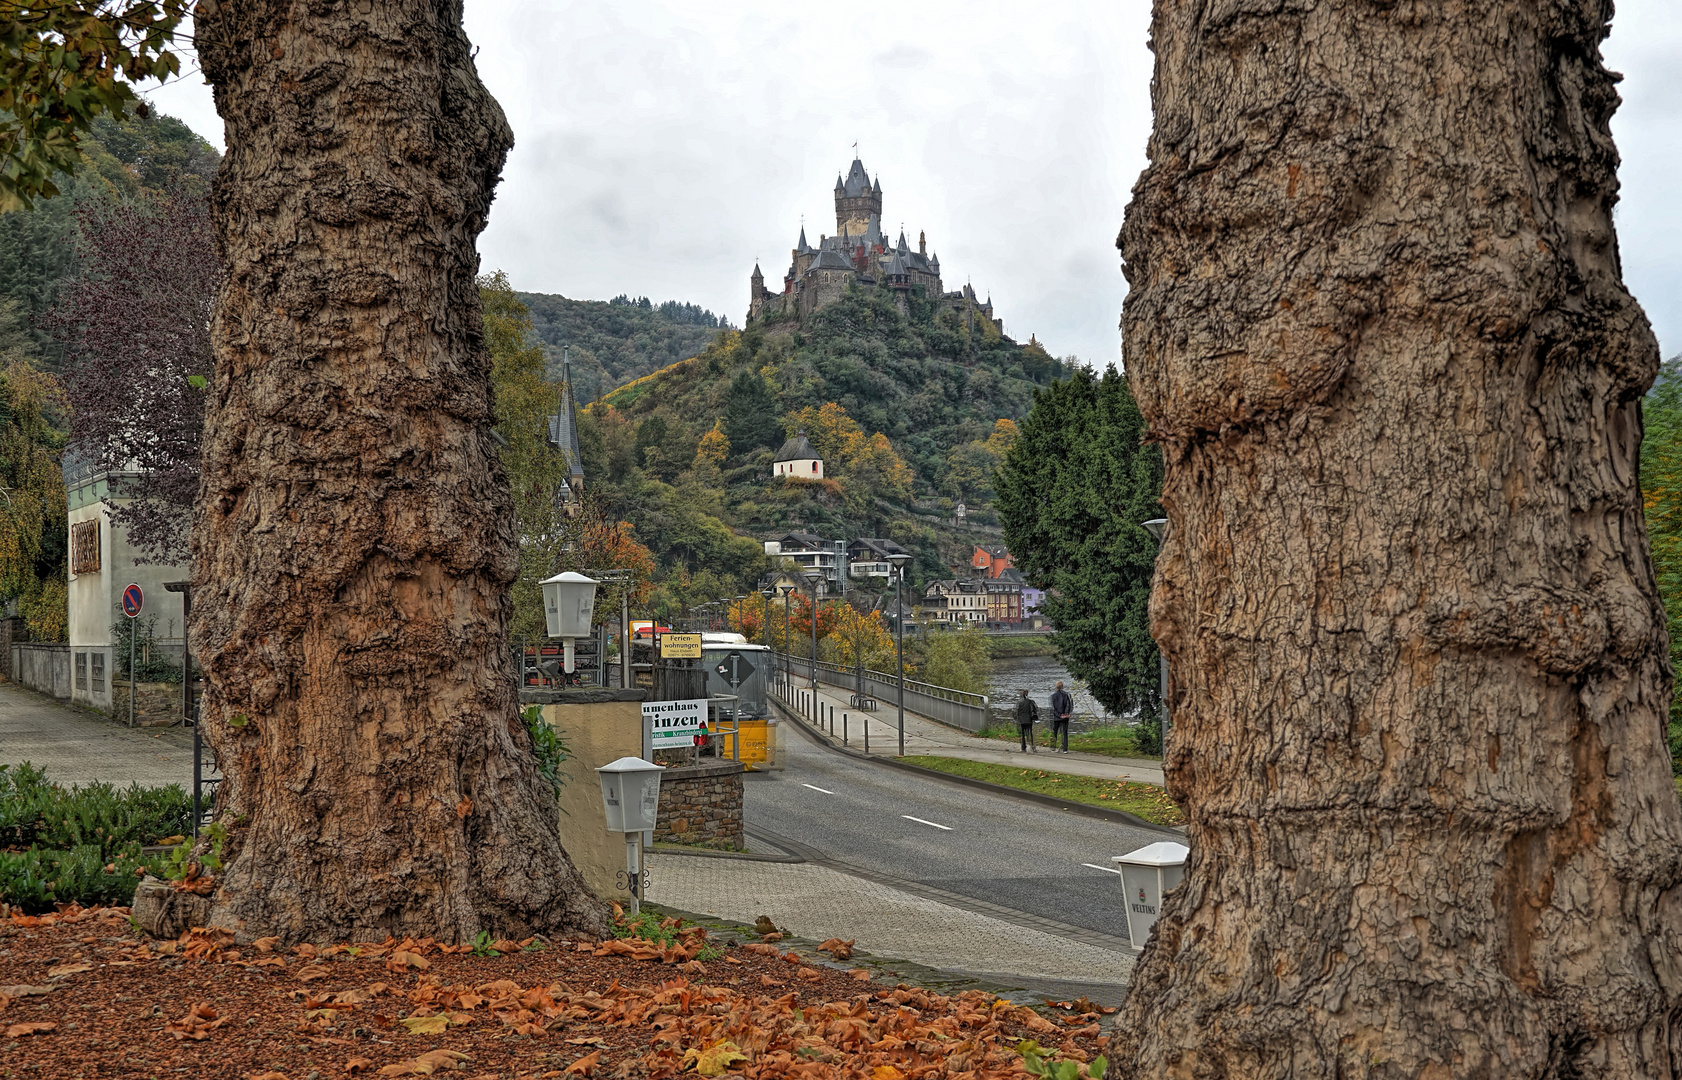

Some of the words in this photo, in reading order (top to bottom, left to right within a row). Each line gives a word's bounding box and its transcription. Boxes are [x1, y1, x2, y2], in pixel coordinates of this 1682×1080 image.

[643, 702, 698, 712] umenhaus
[652, 713, 698, 728] inzen
[1132, 904, 1156, 914] VELTINS
